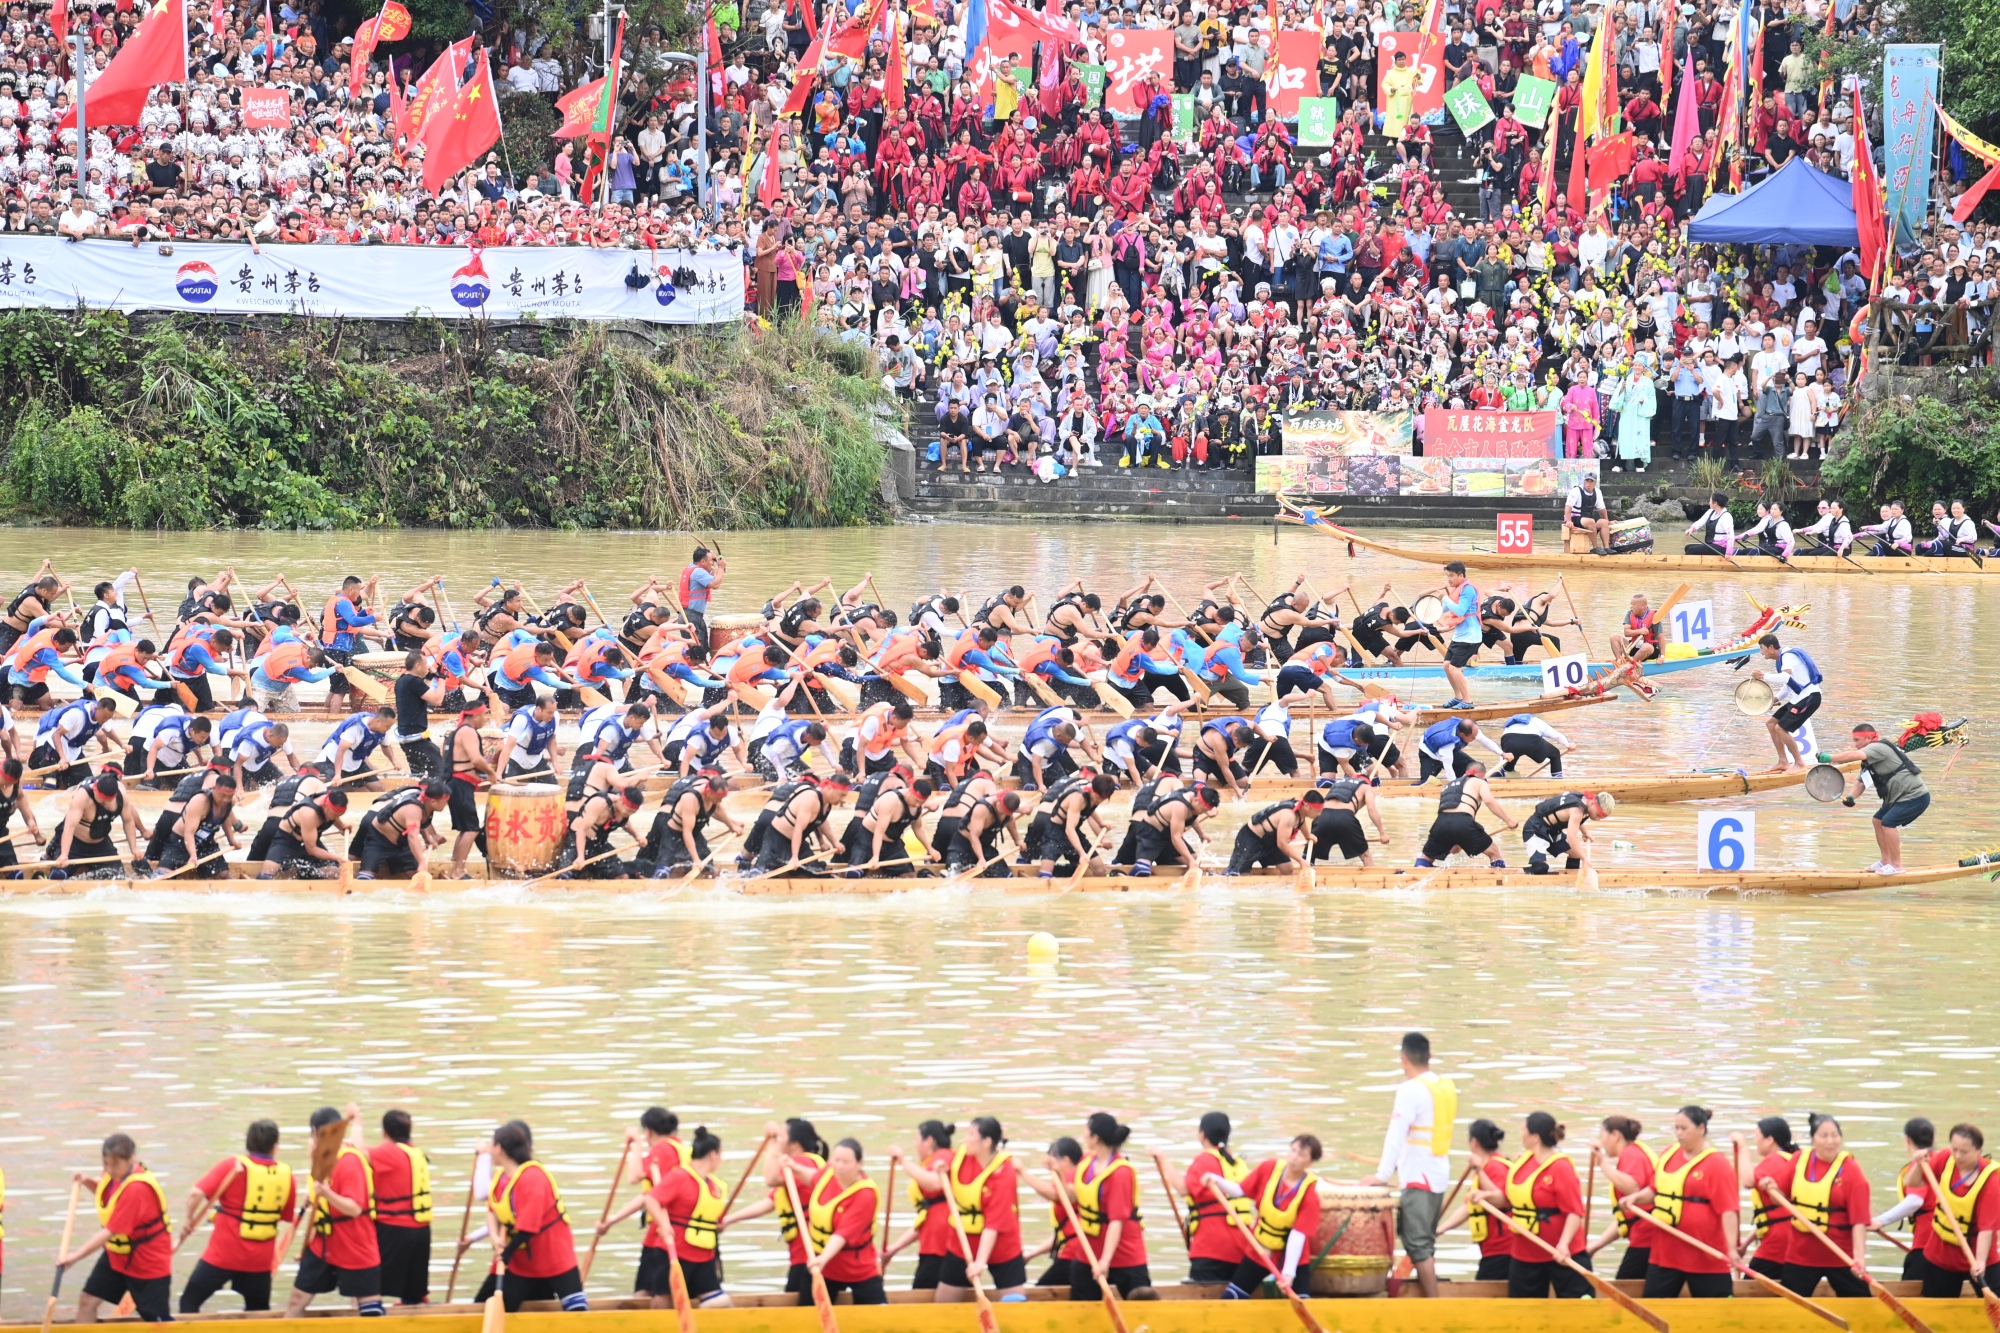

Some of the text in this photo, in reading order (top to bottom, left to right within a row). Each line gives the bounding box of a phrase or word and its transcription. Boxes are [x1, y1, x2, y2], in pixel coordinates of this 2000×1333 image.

[1114, 47, 1167, 95] 塔
[1264, 63, 1307, 99] 加
[1454, 91, 1483, 120] 抹
[1518, 86, 1544, 112] 山
[1310, 105, 1327, 137] 就喝
[0, 257, 37, 285] 茅台
[230, 263, 321, 294] 贵州茅台
[502, 267, 583, 297] 贵州茅台
[183, 287, 212, 295] MOUTAI
[236, 298, 283, 306] KWEICHOW
[1289, 416, 1346, 433] 瓦屋花海金龙
[1447, 415, 1535, 433] 瓦屋花海金龙队
[1500, 520, 1530, 548] 55
[1675, 607, 1711, 643] 14
[1547, 661, 1584, 688] 10
[1708, 817, 1745, 870] 6
